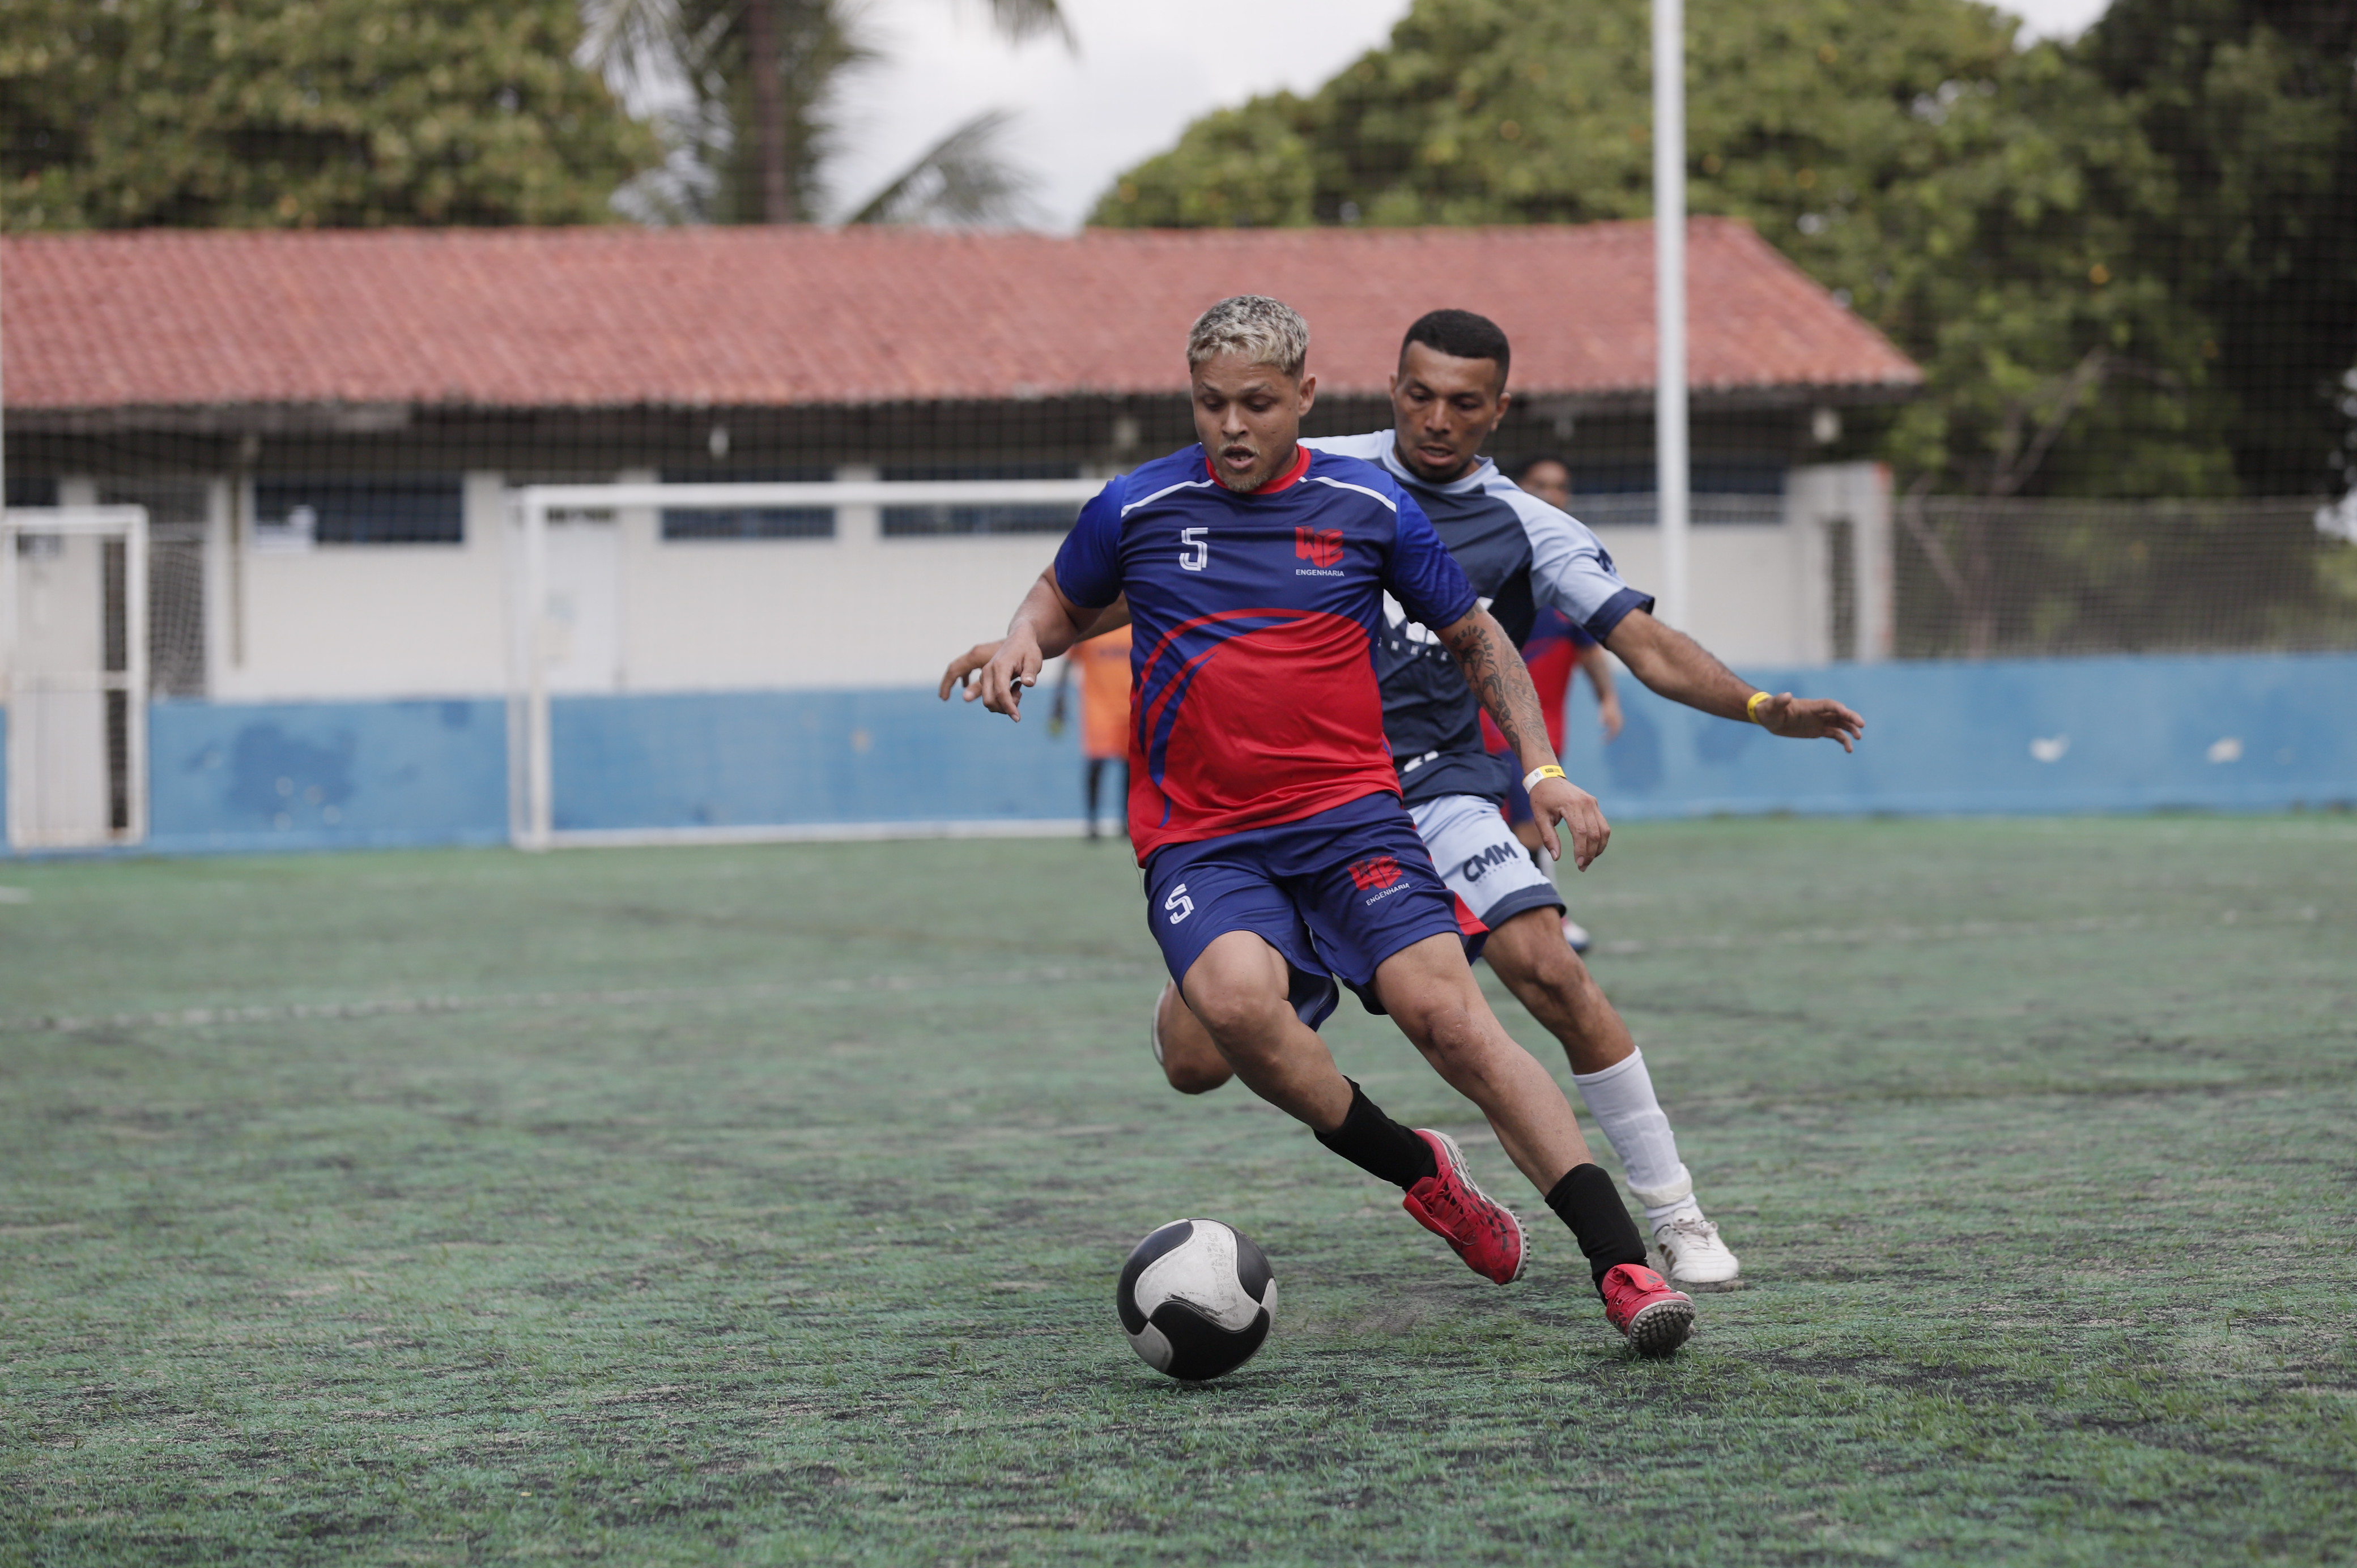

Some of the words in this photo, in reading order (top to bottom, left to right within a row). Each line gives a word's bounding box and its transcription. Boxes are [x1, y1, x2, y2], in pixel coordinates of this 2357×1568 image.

[1178, 527, 1209, 572] 5
[1463, 842, 1519, 882] CMM
[1164, 883, 1194, 924] 5
[1365, 883, 1410, 906] ENGENHARIA
